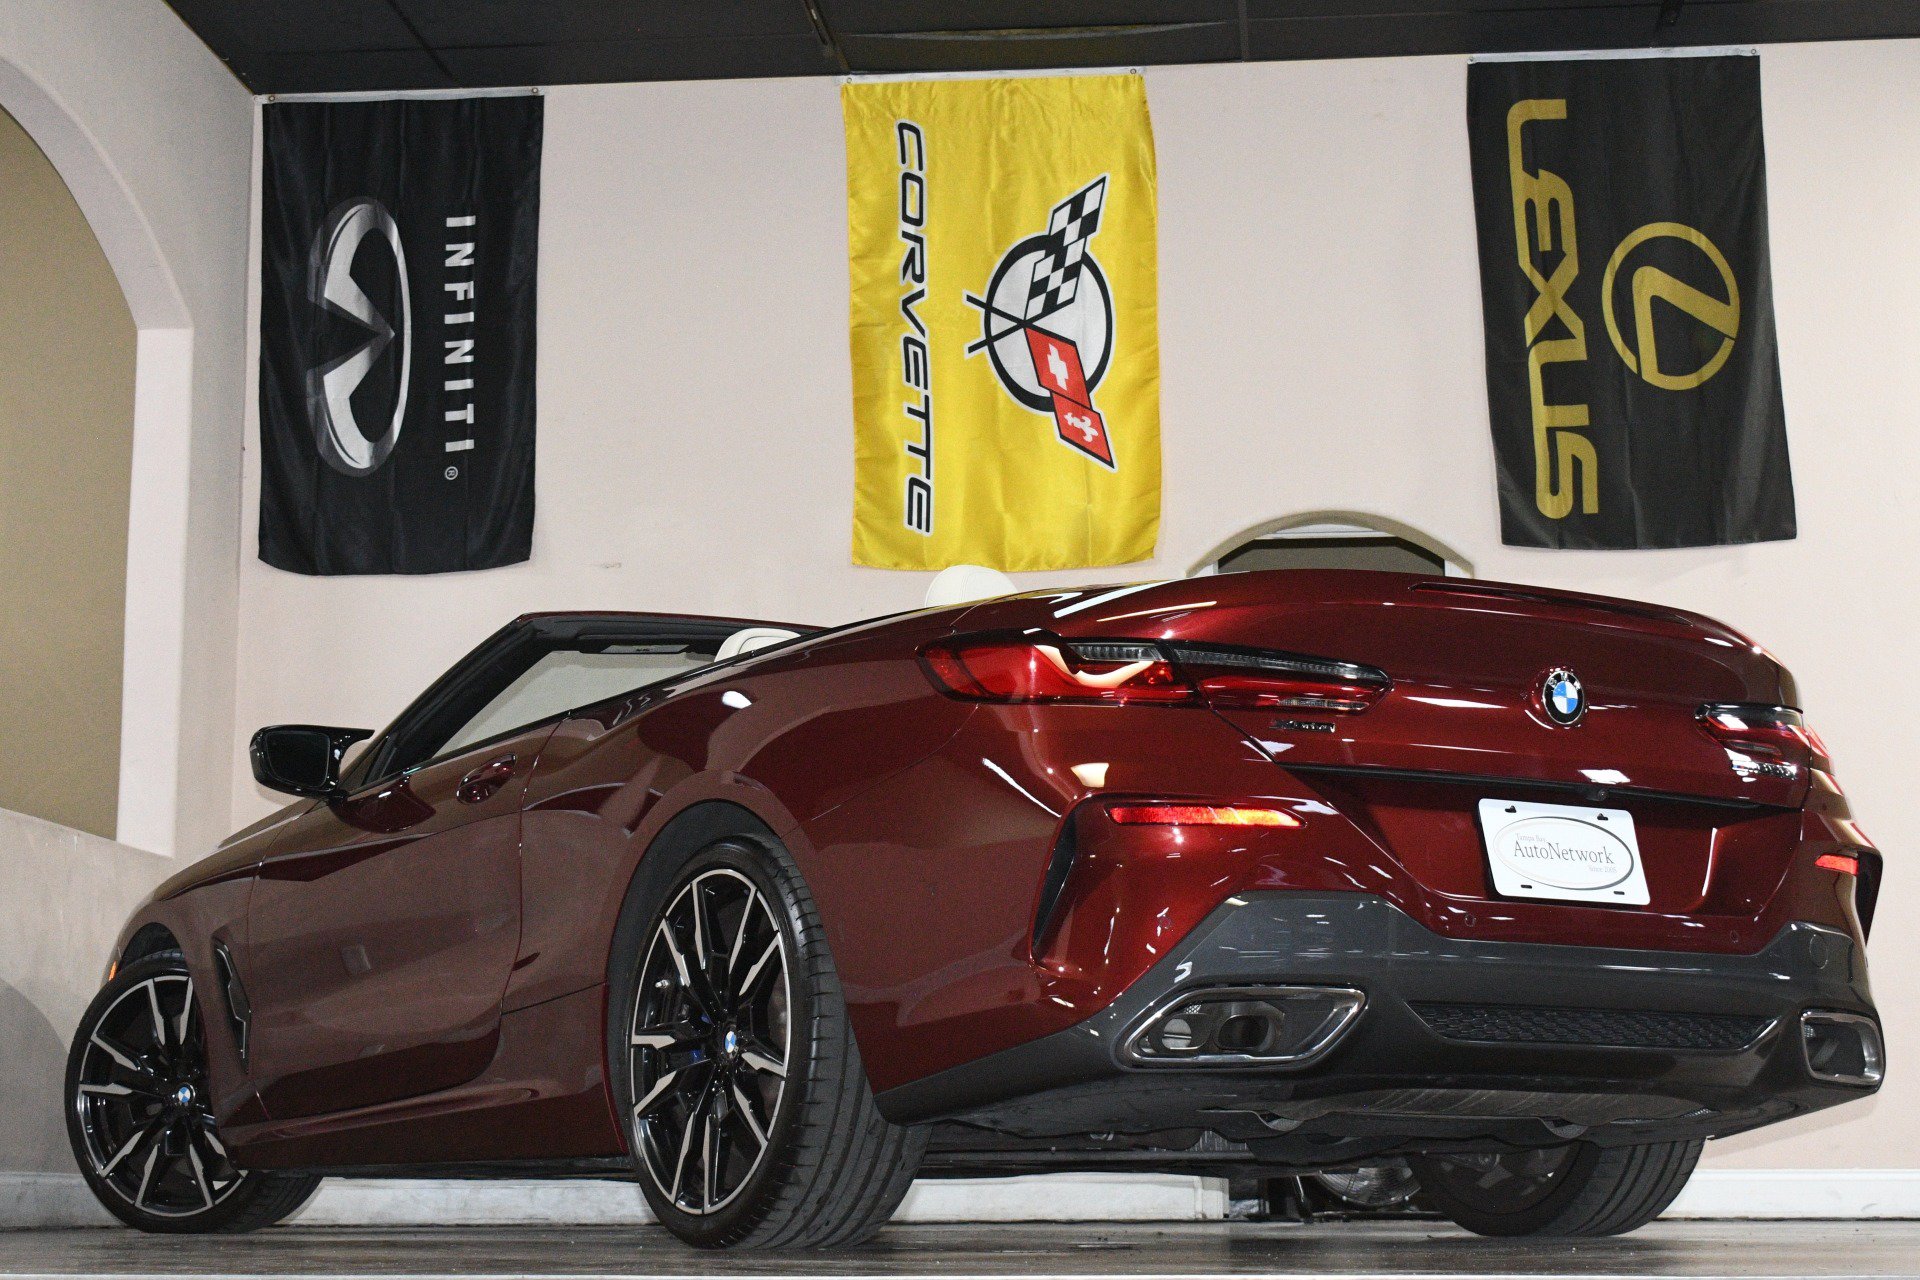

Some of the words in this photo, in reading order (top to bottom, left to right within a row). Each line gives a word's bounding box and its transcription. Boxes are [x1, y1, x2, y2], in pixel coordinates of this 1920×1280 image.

[445, 216, 476, 452] INFINITI
[897, 121, 932, 533] CORVETTE
[1507, 99, 1598, 519] LEXUS
[1514, 840, 1615, 864] AutoNetwork
